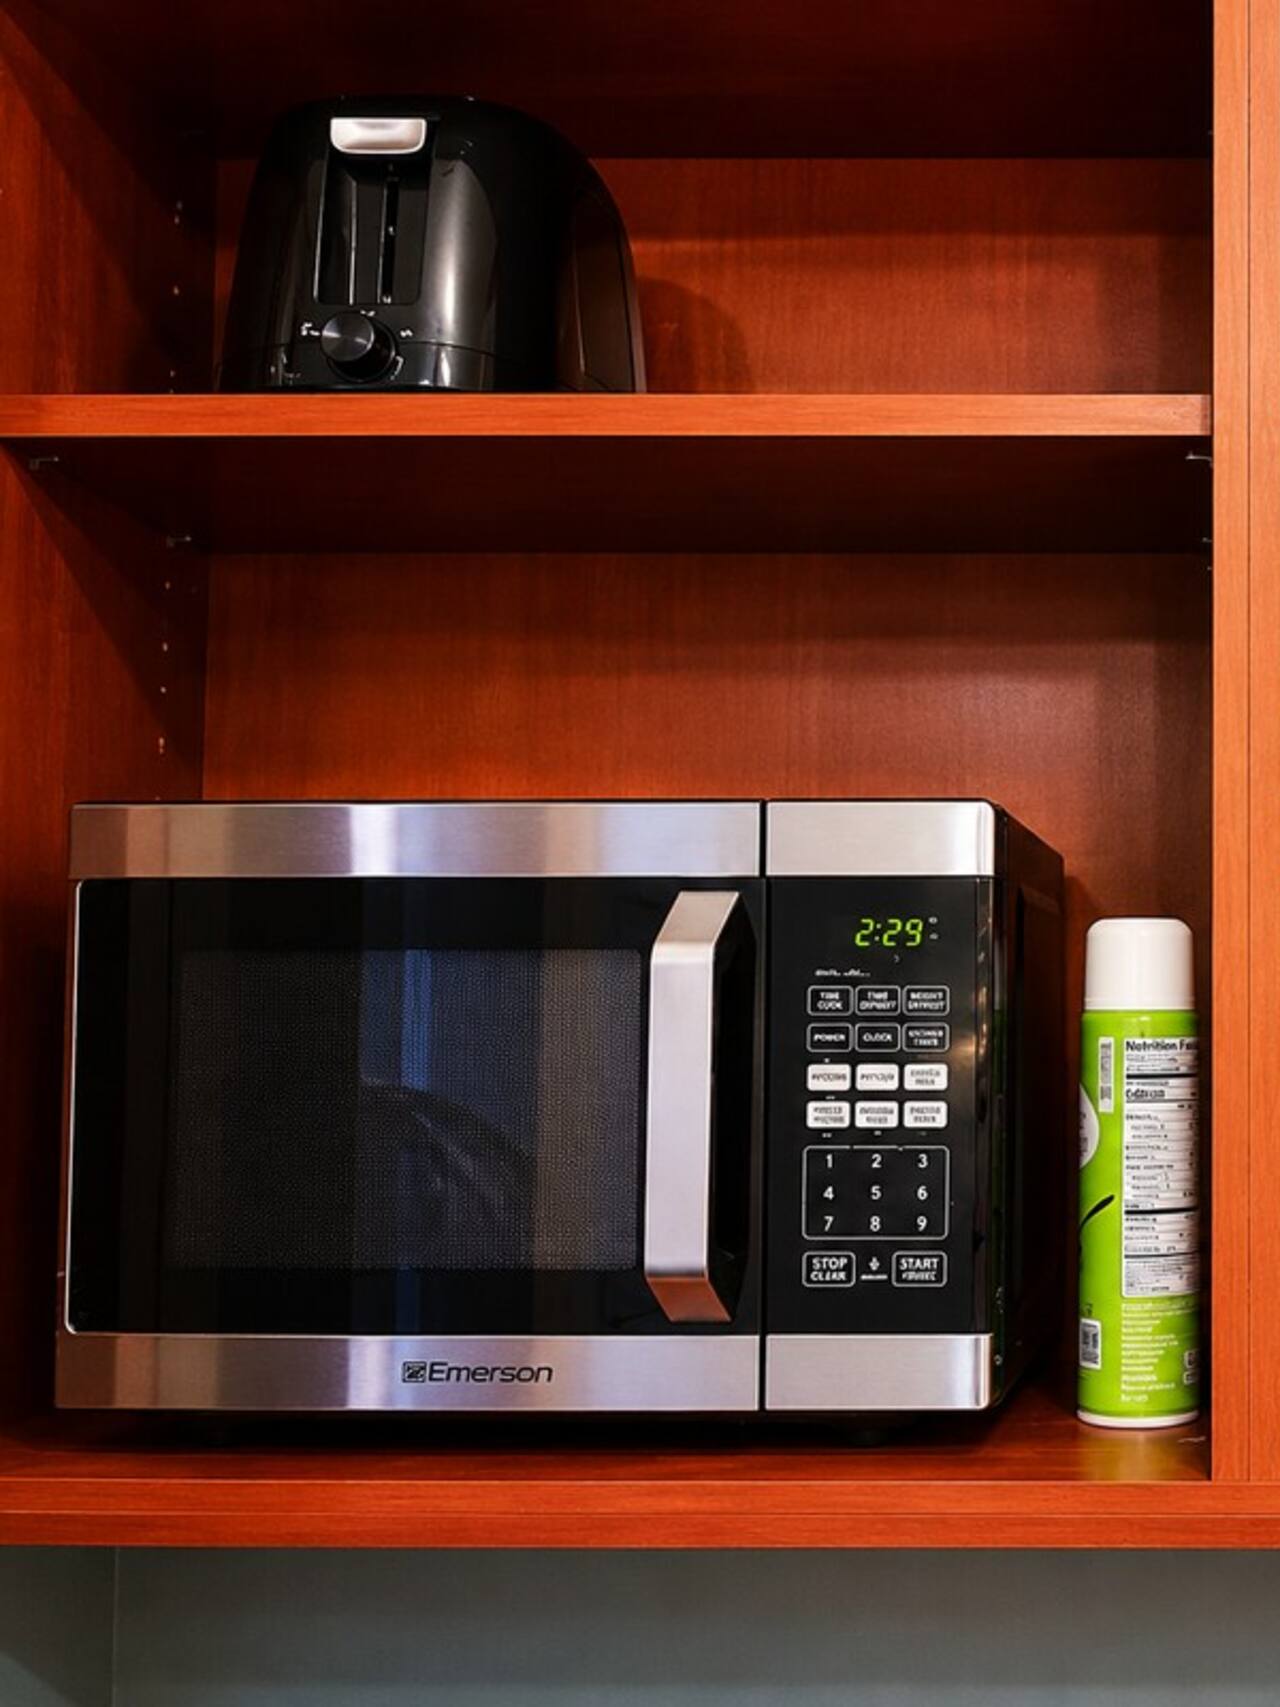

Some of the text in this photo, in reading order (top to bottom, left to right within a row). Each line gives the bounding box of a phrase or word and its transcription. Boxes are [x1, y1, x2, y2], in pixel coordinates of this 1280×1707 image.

[855, 919, 923, 946] 2:29
[826, 1153, 833, 1169] 1
[871, 1153, 882, 1169] 2
[918, 1153, 929, 1169] 3
[823, 1185, 834, 1200] 4
[871, 1185, 882, 1200] 5
[917, 1185, 929, 1200] 6
[824, 1215, 834, 1232] 7
[870, 1215, 881, 1232] 8
[916, 1215, 928, 1232] 9
[812, 1256, 848, 1270] STOP
[900, 1257, 939, 1270] START
[428, 1361, 553, 1383] Emerson
